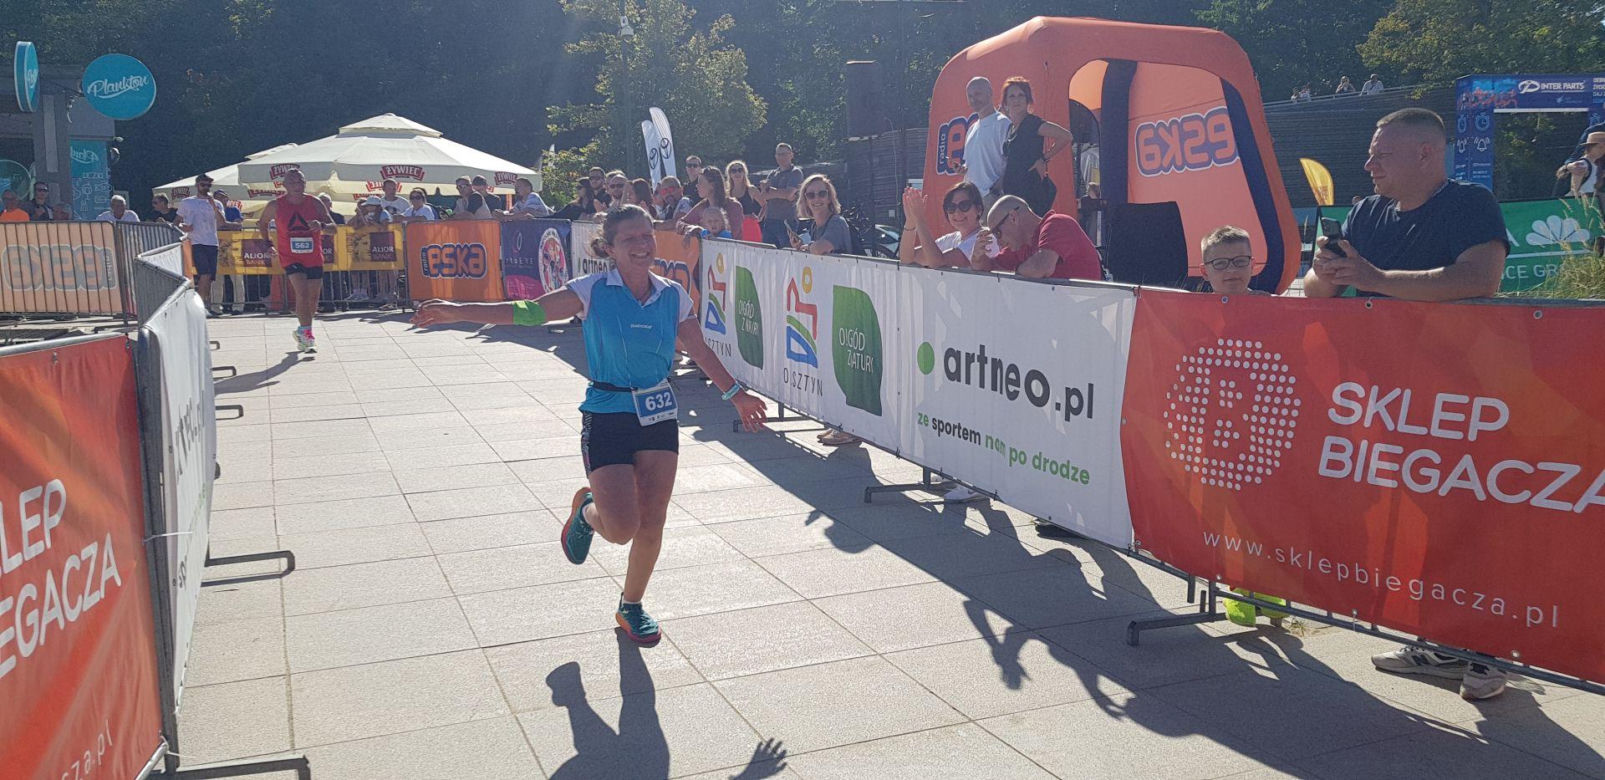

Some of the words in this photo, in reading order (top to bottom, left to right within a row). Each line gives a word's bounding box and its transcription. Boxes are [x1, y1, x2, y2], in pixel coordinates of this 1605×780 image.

[87, 75, 149, 98] Plankton
[1563, 82, 1585, 90] PARTS
[427, 244, 485, 277] eska
[645, 391, 673, 411] 632
[783, 367, 823, 397] OSZTYN
[943, 344, 1094, 422] artneo.pl
[1327, 381, 1510, 441] SKLEP
[917, 412, 930, 427] ze
[931, 416, 981, 446] sportem
[1009, 445, 1028, 467] po
[1031, 451, 1090, 485] drodze
[1318, 435, 1605, 513] BIEGACZA
[0, 478, 67, 577] LEP
[1203, 531, 1558, 628] www.sklepbiegacza.pl
